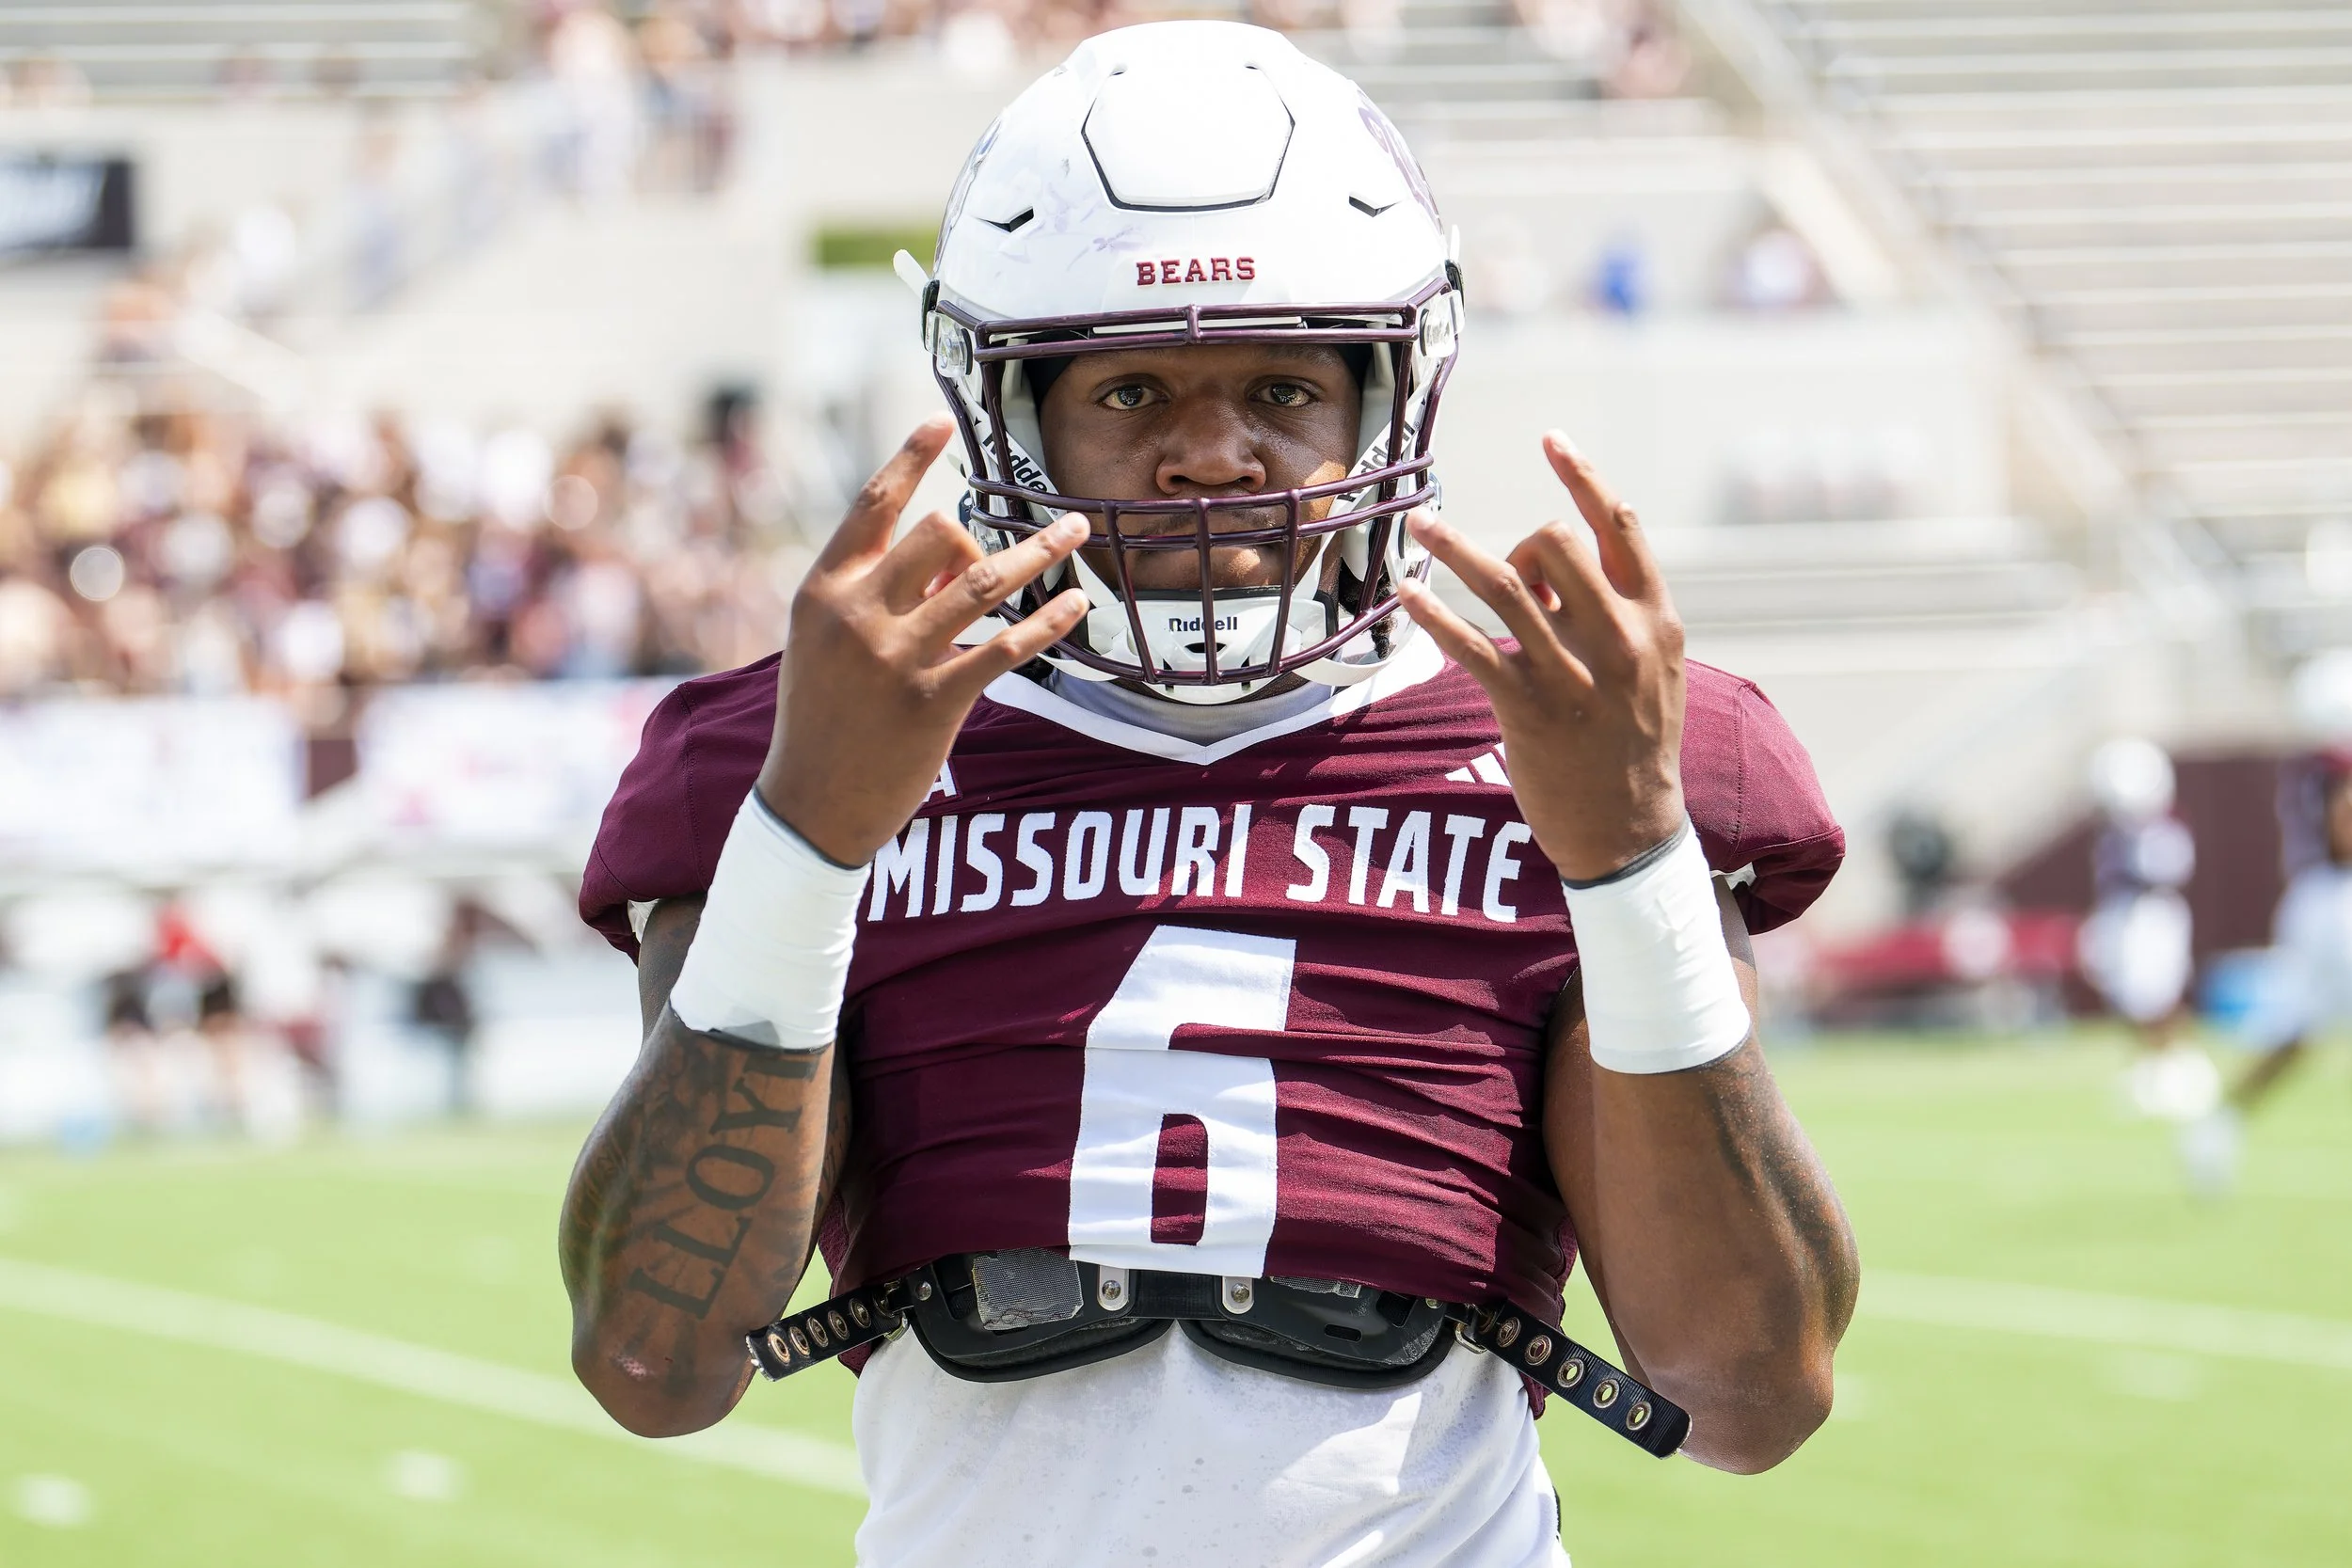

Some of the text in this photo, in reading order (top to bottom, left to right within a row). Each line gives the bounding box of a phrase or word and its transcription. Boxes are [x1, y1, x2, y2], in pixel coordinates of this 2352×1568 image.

[1136, 257, 1255, 286] BEARS
[1168, 616, 1238, 631] Ridell
[867, 805, 1532, 923] MISSOURI STATE
[1069, 926, 1295, 1278] 6
